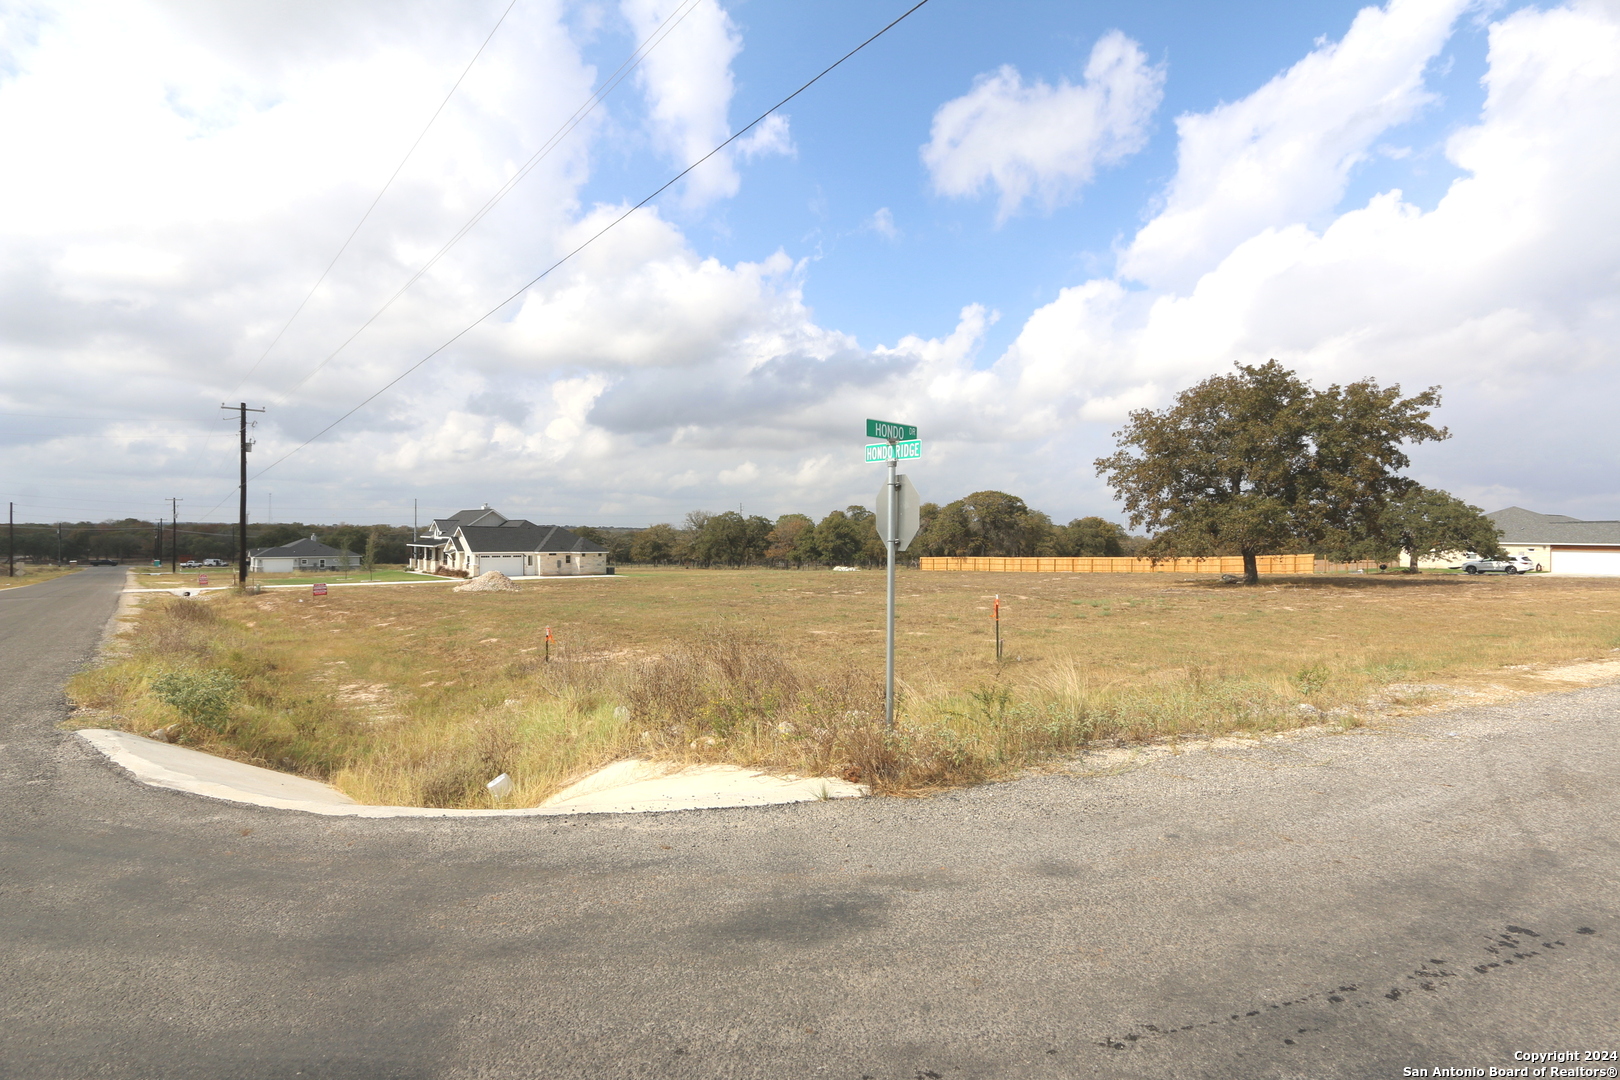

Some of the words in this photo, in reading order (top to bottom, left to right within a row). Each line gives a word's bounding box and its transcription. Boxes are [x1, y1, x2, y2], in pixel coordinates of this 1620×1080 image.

[876, 422, 904, 440] HONDO
[908, 428, 916, 436] DR
[866, 446, 892, 460] HONDO
[896, 443, 919, 458] RIDGE
